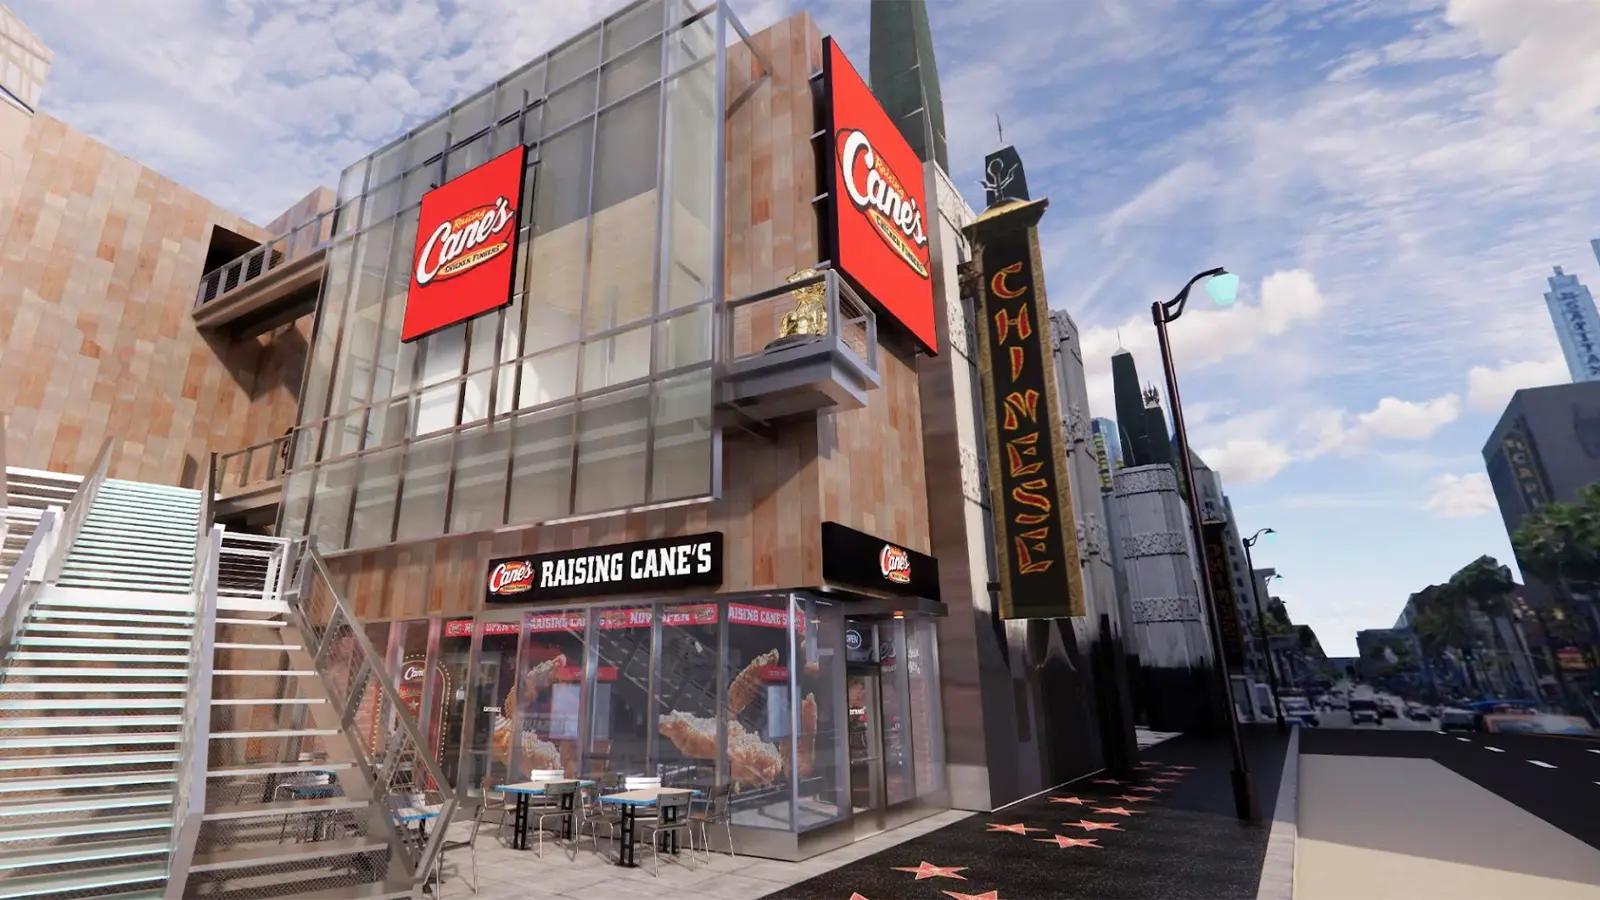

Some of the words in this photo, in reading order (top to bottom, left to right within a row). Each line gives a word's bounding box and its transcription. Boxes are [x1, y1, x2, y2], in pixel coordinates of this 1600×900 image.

[843, 131, 927, 244] Cane's
[417, 197, 514, 284] Cane's
[990, 261, 1054, 576] CHINESE
[489, 560, 535, 593] Cane's
[539, 552, 624, 588] RAISING
[630, 541, 712, 580] CANE'S
[881, 543, 911, 577] Cane's
